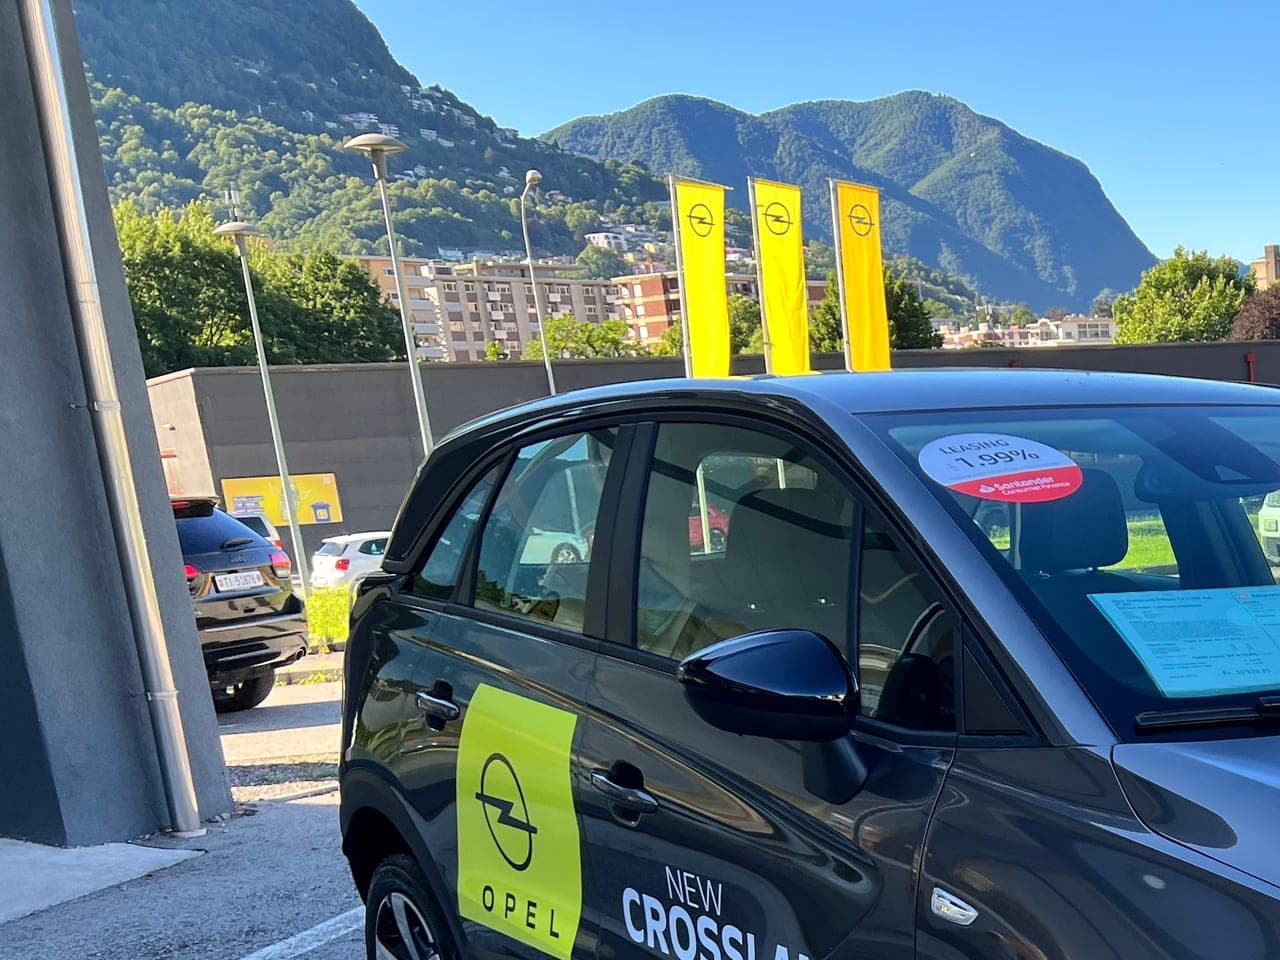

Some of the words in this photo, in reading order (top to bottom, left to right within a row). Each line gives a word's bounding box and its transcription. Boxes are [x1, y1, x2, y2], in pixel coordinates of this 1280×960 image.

[939, 439, 1010, 455] LEASING
[955, 449, 1040, 468] 1.99%
[994, 476, 1055, 491] Santander
[1001, 485, 1041, 496] Consumer
[665, 866, 722, 916] NEW
[482, 885, 560, 939] OPEL
